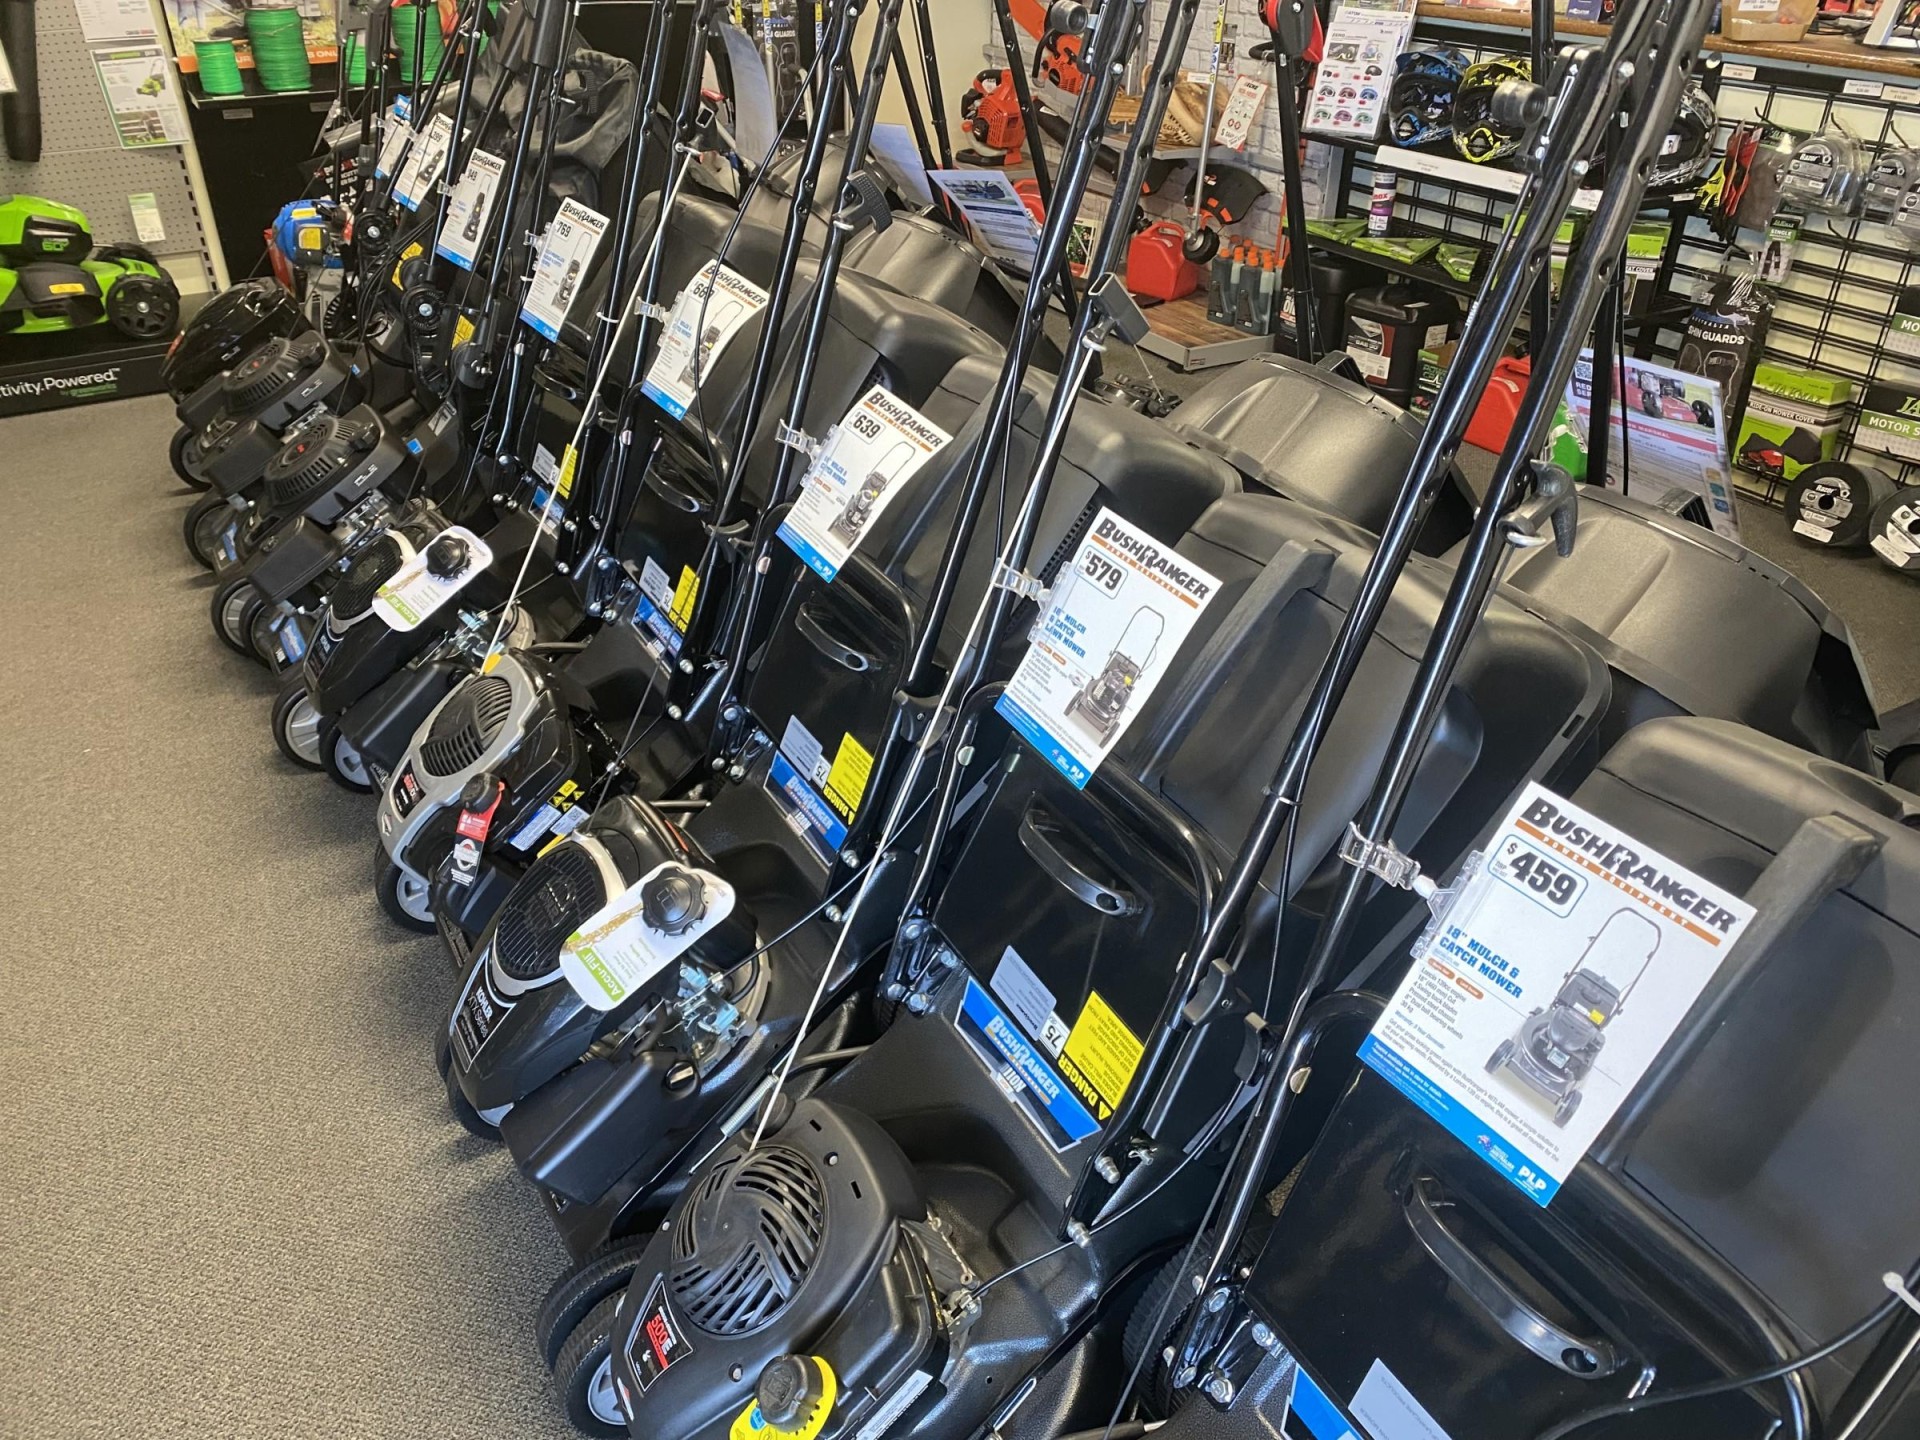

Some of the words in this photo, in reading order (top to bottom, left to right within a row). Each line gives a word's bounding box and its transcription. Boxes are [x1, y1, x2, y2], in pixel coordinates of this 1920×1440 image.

[1800, 153, 1820, 163] Razor
[1877, 166, 1895, 174] Razor
[561, 202, 605, 232] BUSHRANGER
[1702, 331, 1745, 345] GUARDS
[868, 391, 944, 448] BUSHRANGER
[1772, 407, 1795, 418] MOWER
[1795, 414, 1815, 424] COVER
[1868, 416, 1911, 434] MOTOR
[1095, 516, 1211, 601] BUSHRANGER
[1054, 618, 1075, 638] CATCH
[1063, 612, 1087, 635] MULCH
[1062, 635, 1086, 659] MOWER
[1521, 796, 1740, 935] BUSHRANGER
[1541, 835, 1590, 868] POWER
[1598, 869, 1689, 927] EQUIPMENT
[584, 951, 624, 998] Accu-Fill
[1438, 934, 1479, 968] CATCH
[1476, 962, 1523, 999] MOWER
[1466, 937, 1510, 973] MULCH
[1507, 966, 1521, 980] &
[475, 985, 493, 1021] KOHLER
[1408, 986, 1428, 1004] Pressed
[1425, 999, 1439, 1012] steel
[1436, 1007, 1456, 1024] chassis
[1415, 982, 1432, 998] Swing
[1429, 993, 1443, 1006] back
[1440, 1001, 1458, 1017] blades
[1448, 987, 1467, 1004] engine
[1409, 997, 1422, 1009] Dual
[1419, 1005, 1430, 1016] ball
[1428, 1011, 1448, 1029] bearing
[1445, 1024, 1464, 1041] wheels
[986, 1014, 1062, 1100] BUSHRANGER
[1428, 1048, 1442, 1061] green
[1440, 1057, 1453, 1070] again
[1451, 1066, 1462, 1077] with
[1057, 1053, 1099, 1107] DANGER
[1518, 1165, 1547, 1192] PLP
